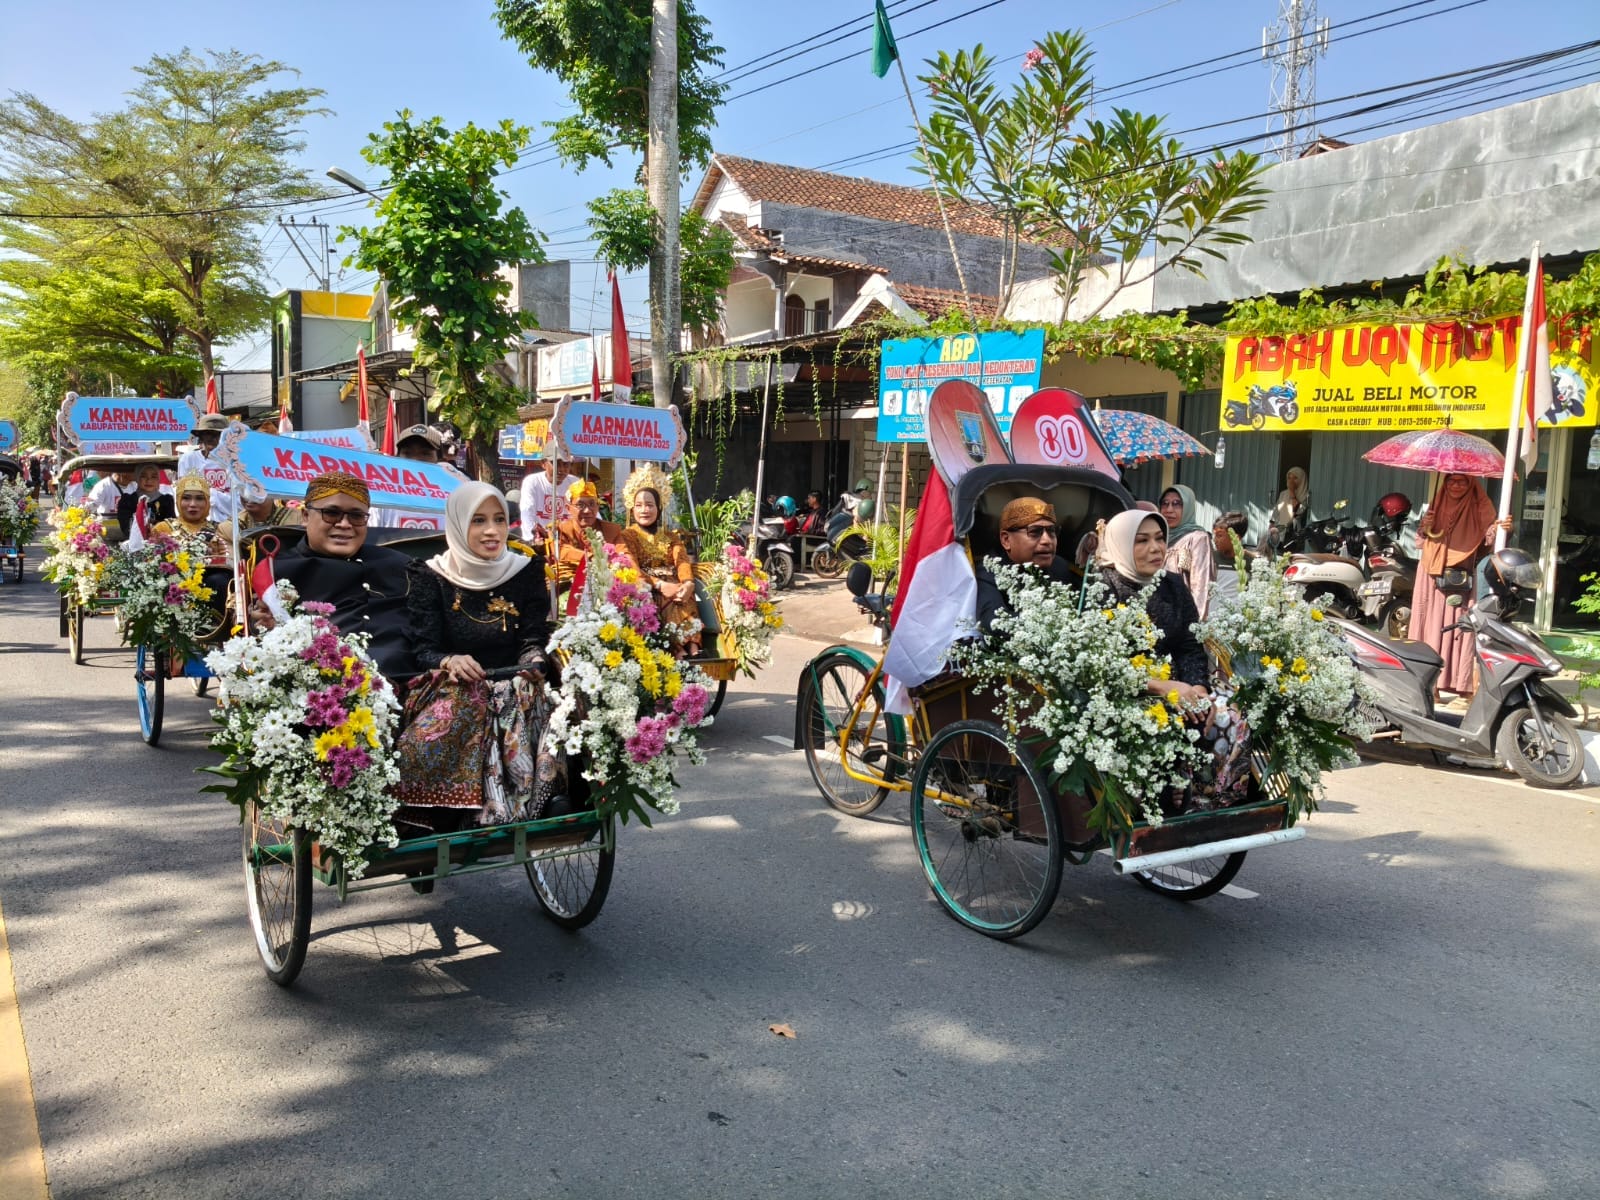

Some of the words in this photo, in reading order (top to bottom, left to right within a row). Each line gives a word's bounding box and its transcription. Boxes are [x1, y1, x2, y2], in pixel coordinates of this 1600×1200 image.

[939, 337, 976, 362] ABP
[1233, 328, 1332, 382] ABAH
[1342, 324, 1411, 377] UQI
[983, 359, 1036, 375] KEDOKTERAN
[982, 376, 1013, 386] KESEHATAN
[1312, 388, 1354, 402] JUAL
[1363, 387, 1402, 401] BELI
[1410, 385, 1477, 400] MOTOR
[89, 407, 178, 424] KARNAVAL
[1380, 404, 1402, 412] MOTOR
[1407, 404, 1423, 412] MOBIL
[1452, 403, 1486, 411] INDONESIA
[80, 422, 128, 431] KABUPATEN
[129, 423, 167, 431] REMBANG
[169, 423, 188, 432] 2025
[582, 414, 662, 439] KARNAVAL
[1327, 418, 1343, 426] CASH
[1349, 418, 1372, 426] CREDIT
[1377, 418, 1392, 426] HUB
[94, 441, 140, 451] KARNAVAL
[572, 433, 617, 446] KABUPATEN
[618, 436, 652, 449] REMBANG
[653, 439, 670, 450] 2025
[1035, 415, 1087, 464] 80
[273, 447, 441, 490] KARNAVAL
[369, 482, 426, 497] EMBANG
